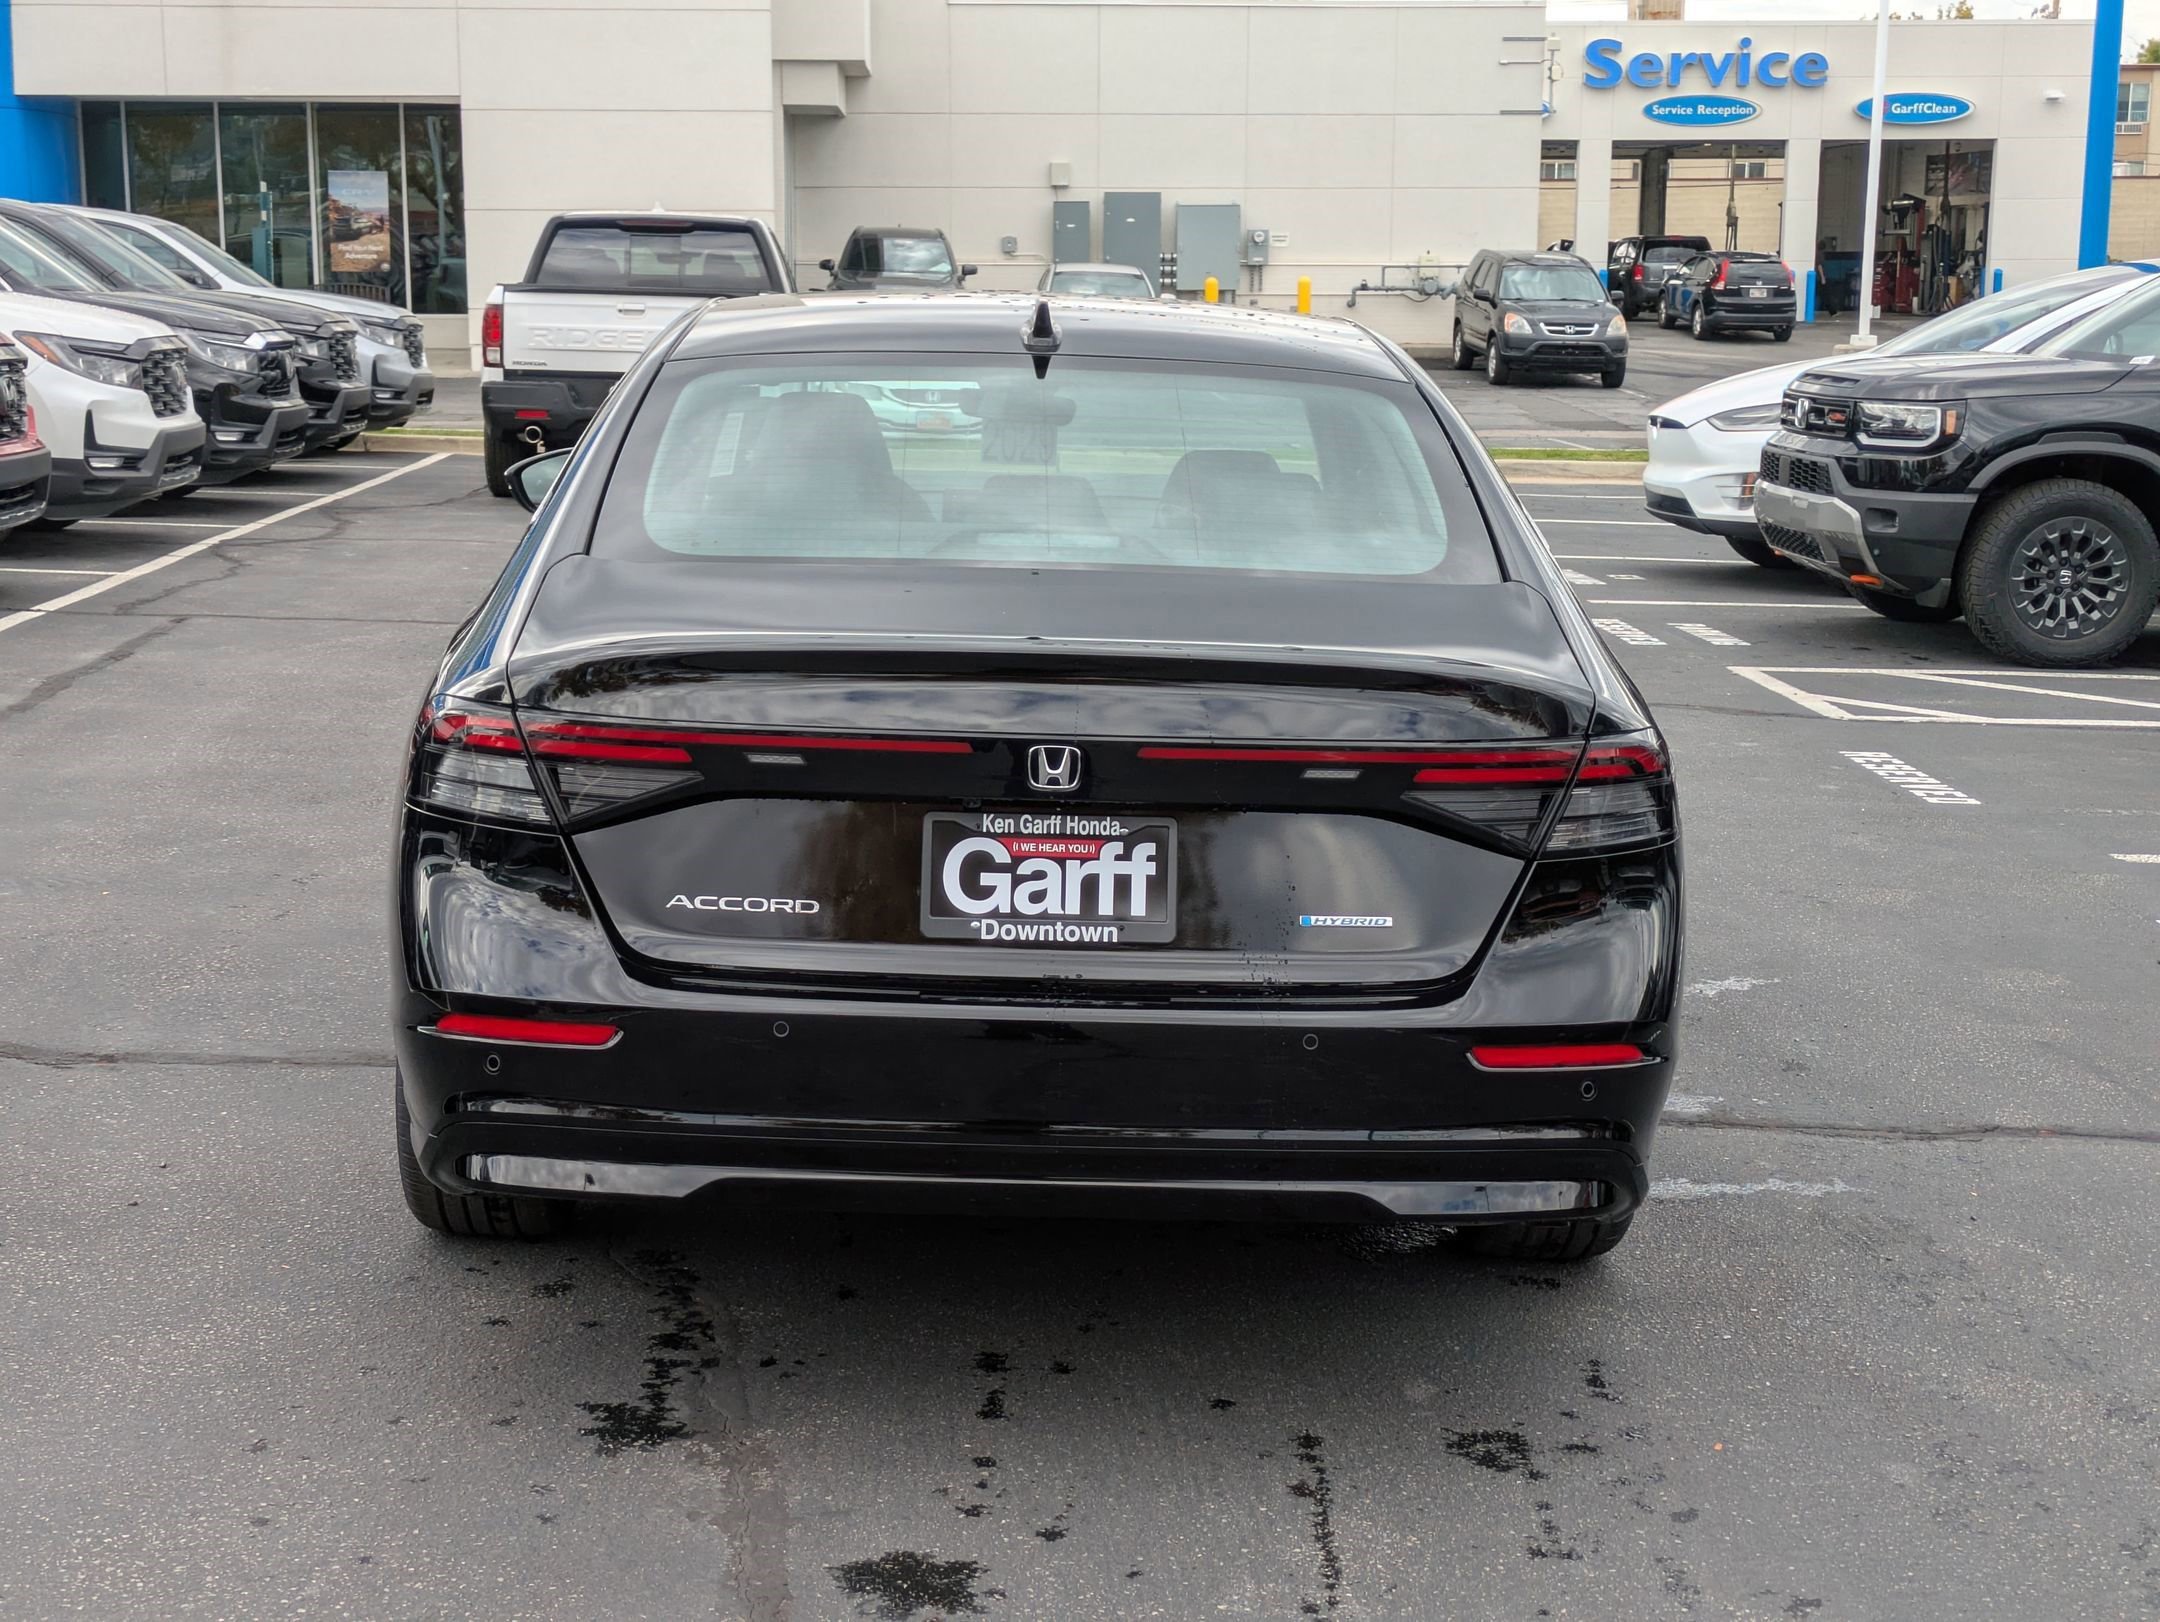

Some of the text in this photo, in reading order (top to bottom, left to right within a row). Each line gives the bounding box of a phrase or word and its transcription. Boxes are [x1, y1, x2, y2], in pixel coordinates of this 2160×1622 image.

[1583, 37, 1829, 88] Service
[1652, 104, 1753, 117] Service Reception
[1891, 102, 1957, 114] GarffClean
[528, 327, 655, 349] RIDGE
[1838, 751, 1982, 805] RESERVED
[982, 813, 1121, 836] Ken Garff Honda
[1020, 843, 1089, 854] WE HEAR YOU
[942, 836, 1157, 916] Garff
[665, 894, 820, 913] ACCORD
[980, 919, 1118, 943] Downtown
[1313, 917, 1388, 926] HYBRID
